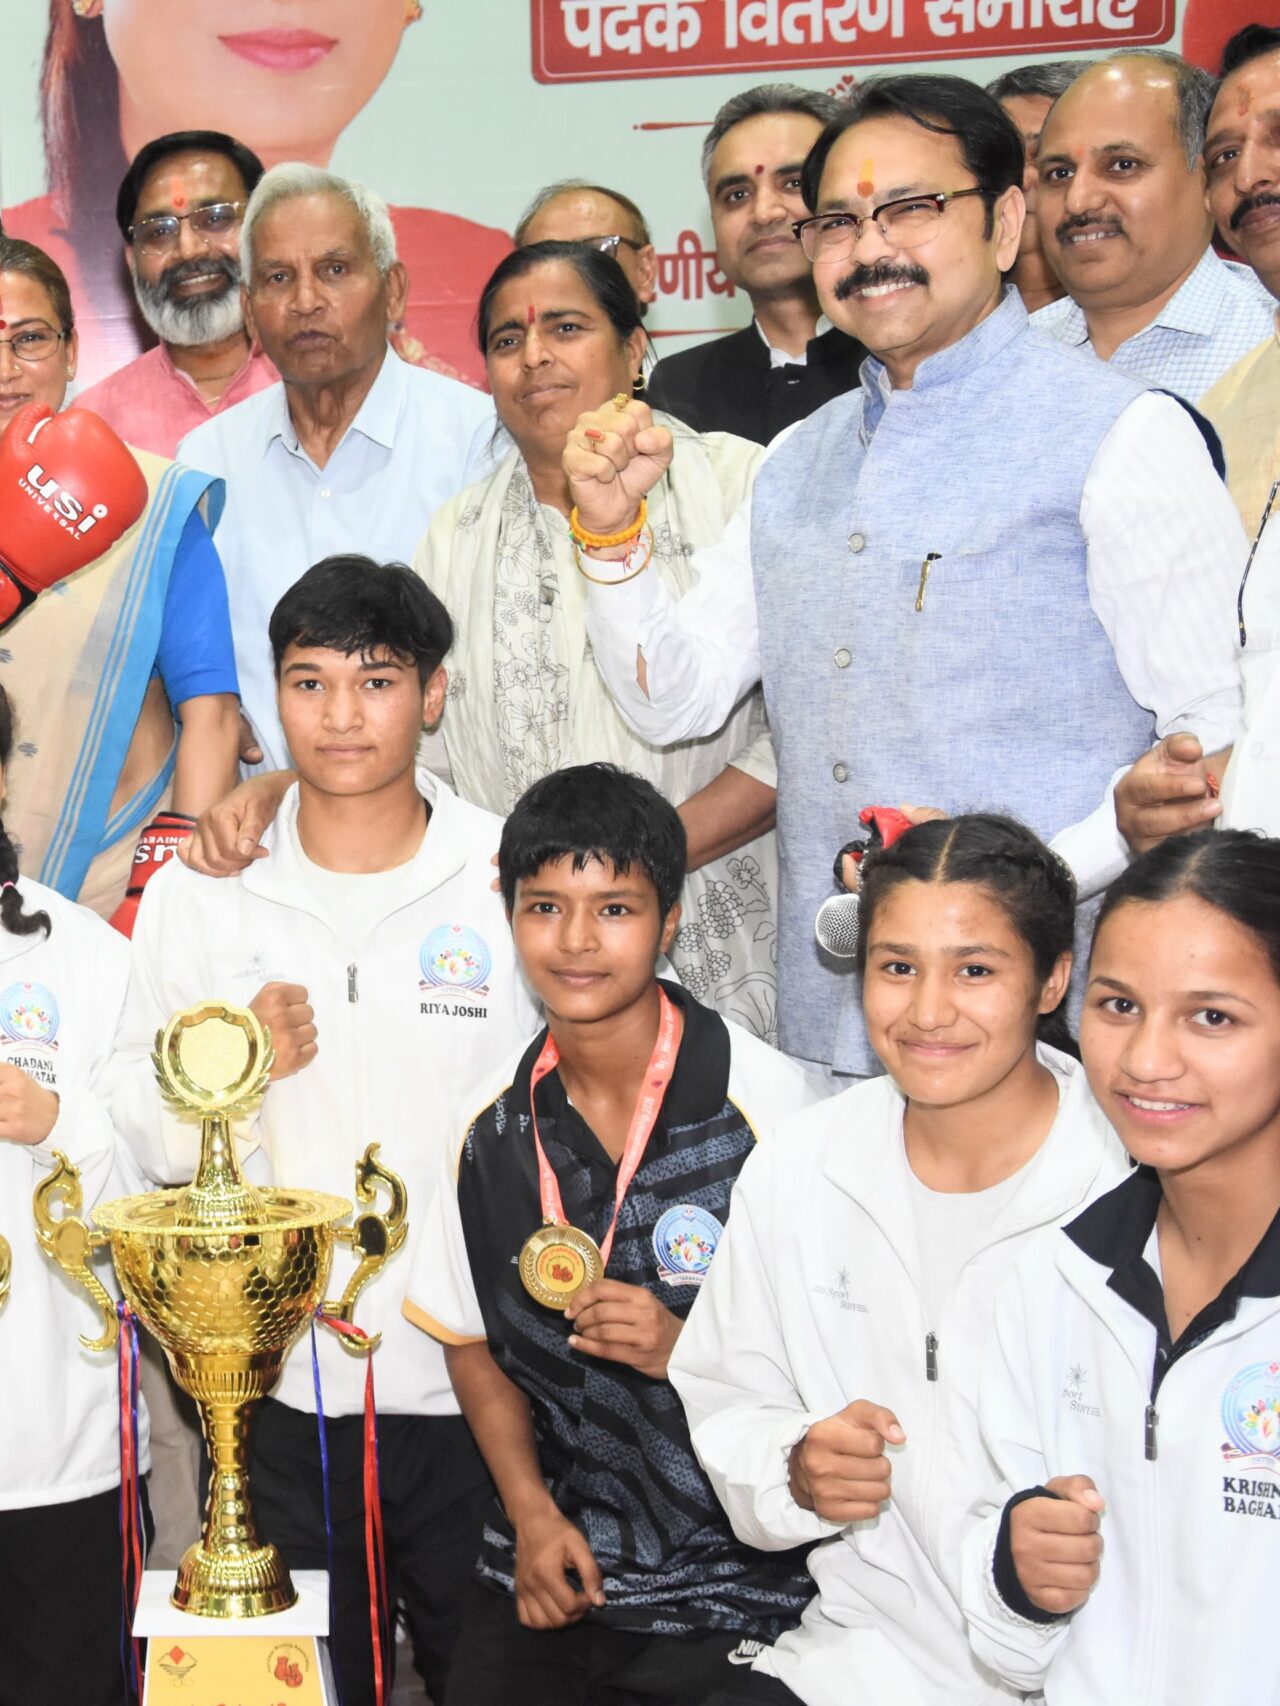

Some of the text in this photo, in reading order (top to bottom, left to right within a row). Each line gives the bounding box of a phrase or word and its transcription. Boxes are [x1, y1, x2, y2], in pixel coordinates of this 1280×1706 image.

[18, 478, 82, 541] UNIVERSAL
[420, 1002, 487, 1018] RIYA JOSHI
[1222, 1476, 1280, 1499] KRISHN
[1224, 1496, 1280, 1520] BAGHA
[737, 1639, 765, 1657] NIK
